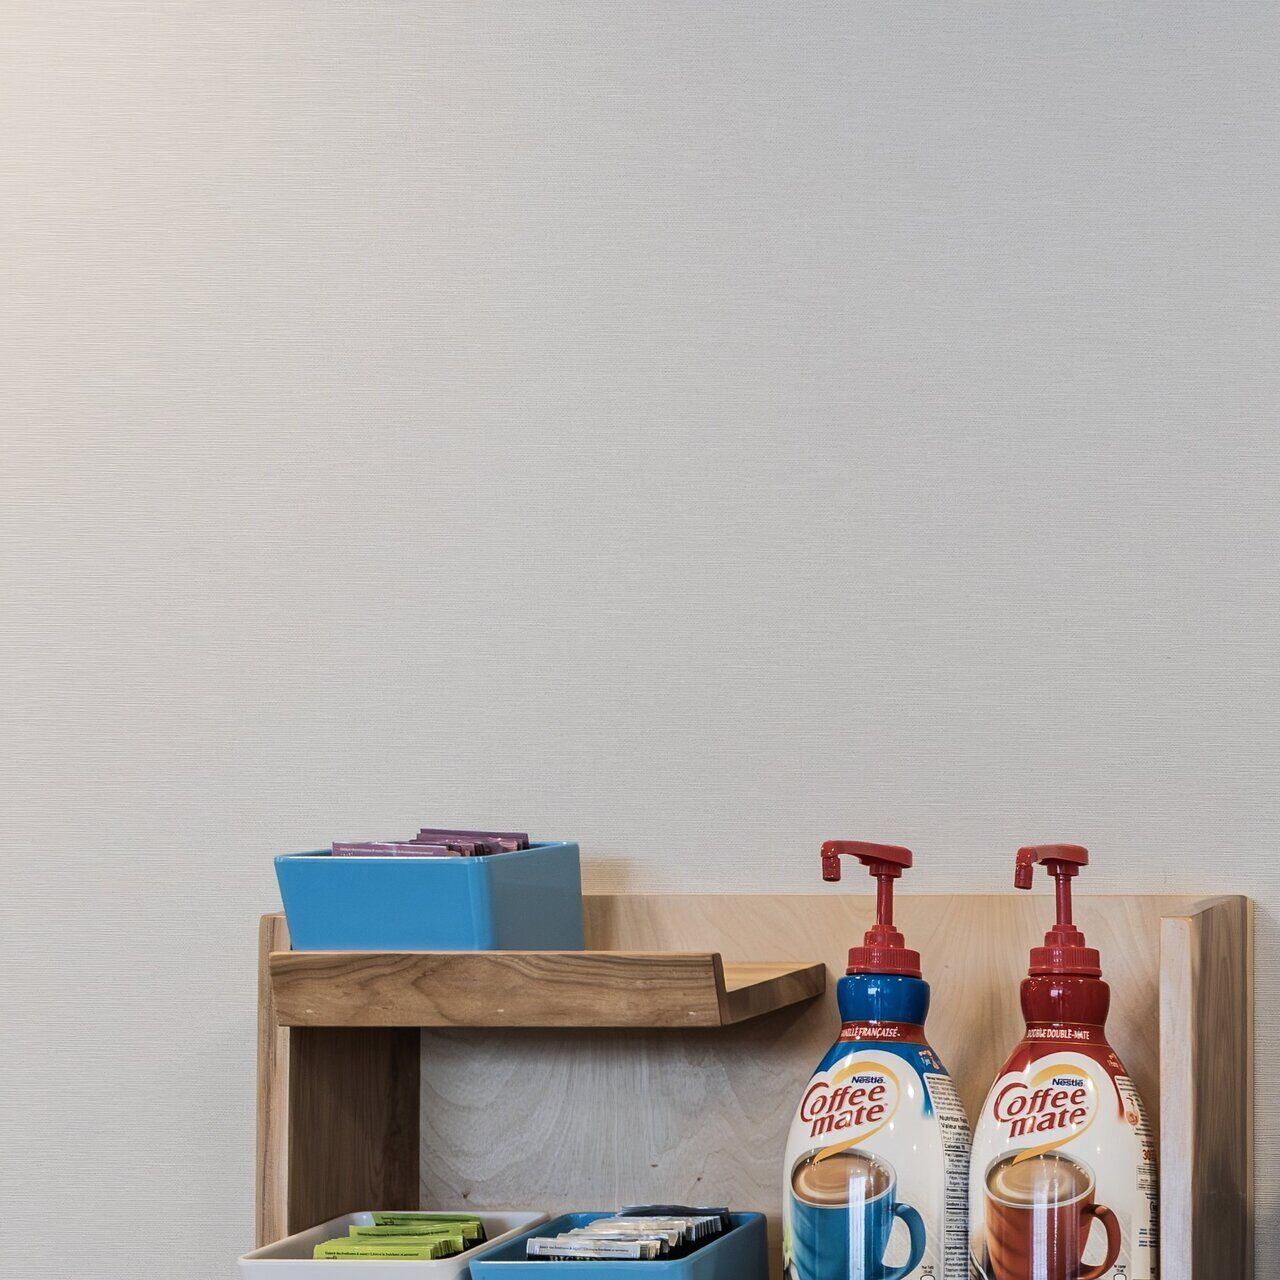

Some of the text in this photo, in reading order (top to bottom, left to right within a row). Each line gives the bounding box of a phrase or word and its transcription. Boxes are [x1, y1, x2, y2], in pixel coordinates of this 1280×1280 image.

[801, 1082, 886, 1122] Coffee
[994, 1082, 1087, 1123] Coffee
[810, 1105, 884, 1137] mate
[1008, 1107, 1087, 1138] mate
